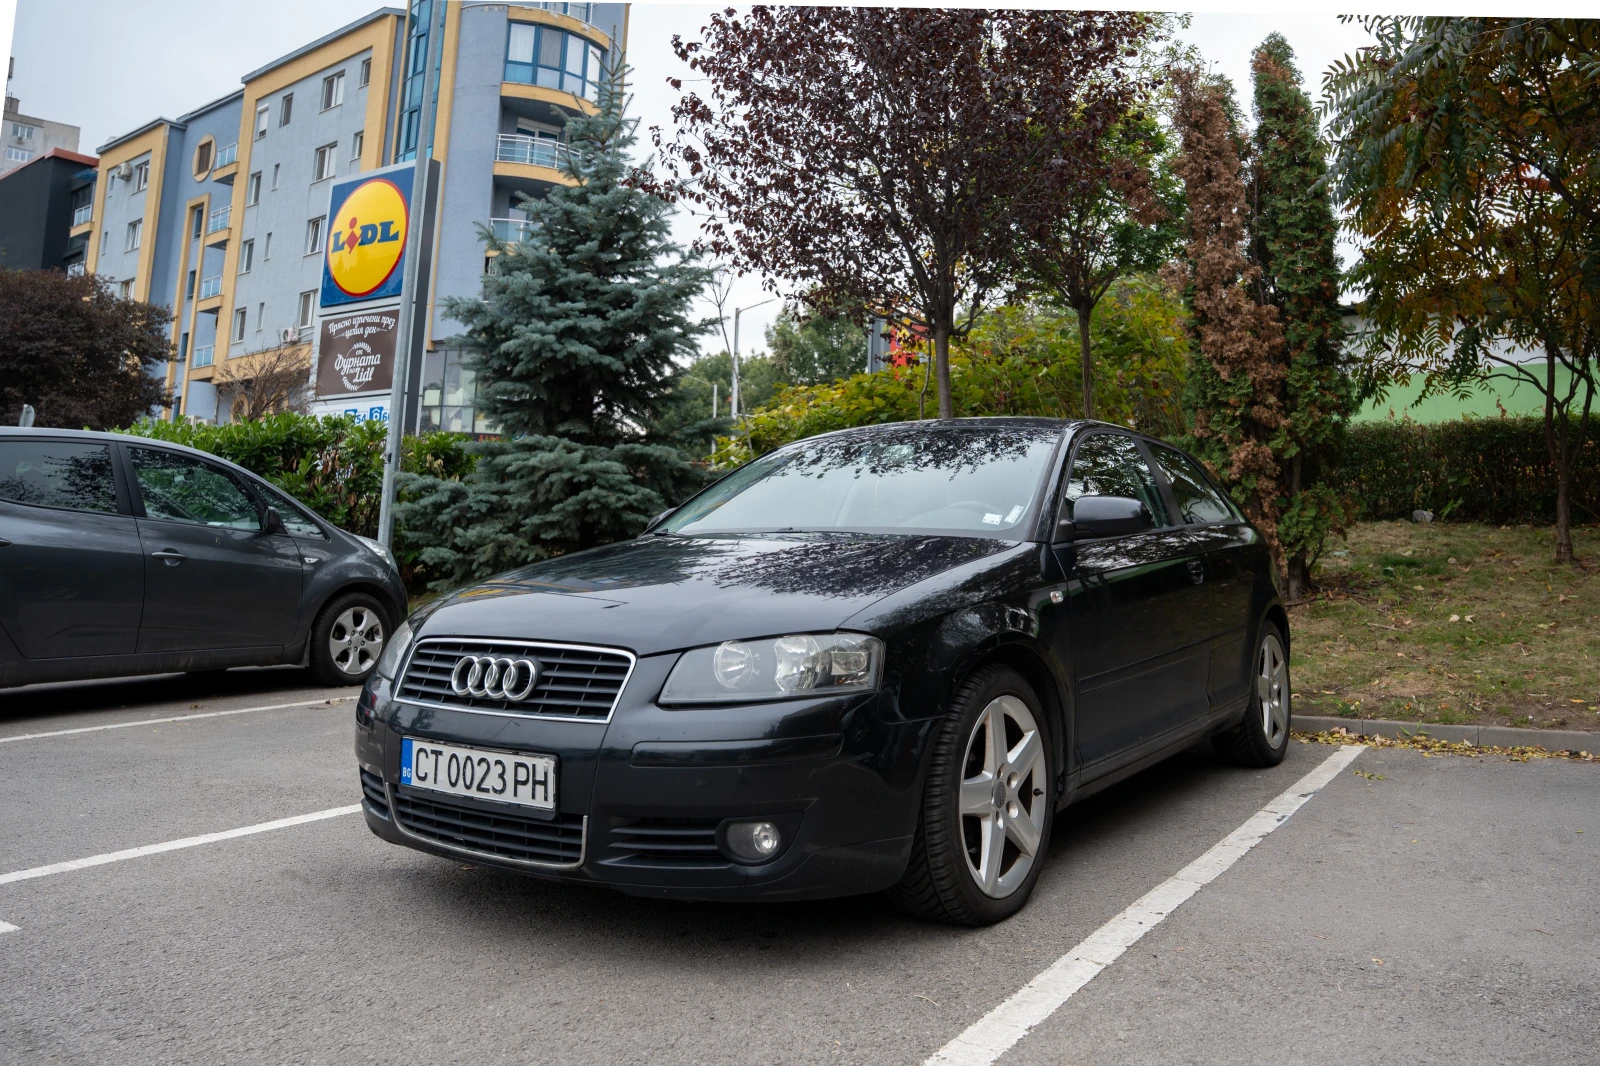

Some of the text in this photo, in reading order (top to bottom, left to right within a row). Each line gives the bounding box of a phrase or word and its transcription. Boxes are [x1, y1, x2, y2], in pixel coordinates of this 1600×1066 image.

[328, 315, 396, 336] Прясно изпечени през
[345, 326, 377, 339] целия ден
[334, 353, 381, 375] Фурната
[353, 366, 375, 383] Lidl
[402, 766, 412, 778] BG
[447, 752, 507, 795] 0023
[513, 761, 549, 802] PH
